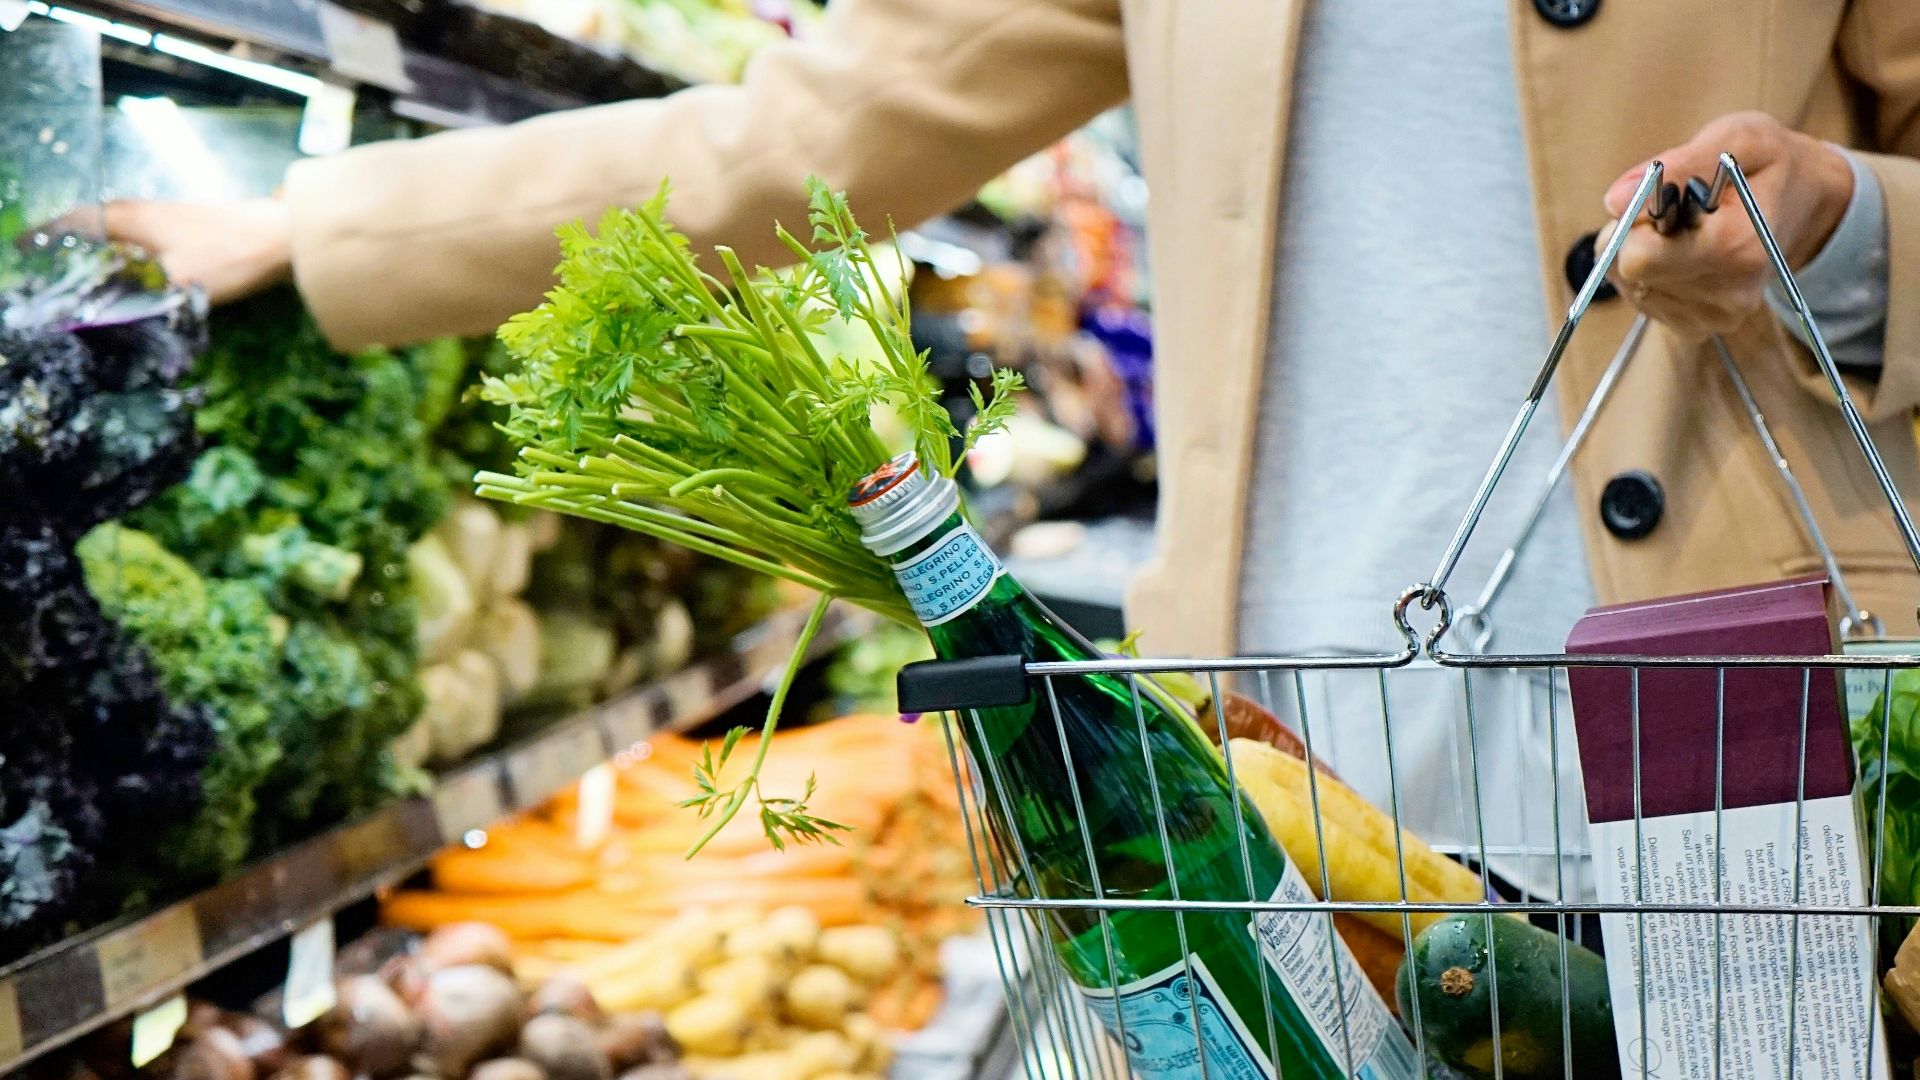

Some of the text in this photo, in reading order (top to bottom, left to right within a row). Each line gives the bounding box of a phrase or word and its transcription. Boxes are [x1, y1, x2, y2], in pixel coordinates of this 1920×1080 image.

[1681, 828, 1694, 850] Seul
[1703, 832, 1714, 846] de
[1821, 823, 1836, 866] delicious
[1616, 845, 1627, 869] vous
[1646, 836, 1663, 880] Délicieux
[1684, 852, 1693, 865] un
[1743, 848, 1757, 884] cheese
[1754, 847, 1766, 864] but
[1764, 841, 1779, 869] these
[1834, 845, 1849, 877] Lesley
[1619, 870, 1629, 883] ne
[1755, 865, 1769, 892] really
[1804, 862, 1816, 879] her
[1653, 881, 1662, 894] au
[1685, 866, 1700, 900] produit
[1748, 885, 1757, 896] or
[1768, 870, 1782, 903] unique
[1807, 881, 1818, 906] team
[1840, 878, 1853, 906] Stow
[1624, 921, 1637, 943] plus
[1648, 921, 1658, 934] de
[1679, 912, 1695, 948] pouvait
[1764, 920, 1776, 946] when
[1800, 921, 1813, 955] scratch
[1823, 921, 1835, 942] with
[1660, 932, 1669, 950] ces
[1670, 928, 1684, 960] POUR
[1728, 934, 1741, 964] Foods
[1744, 935, 1754, 944] &
[1814, 932, 1824, 948] the
[1834, 924, 1849, 965] fabulous
[1847, 934, 1861, 965] Foods
[1694, 842, 1704, 865] avec
[1722, 1057, 1733, 1070] de
[1745, 945, 1755, 962] are
[1756, 944, 1767, 960] We
[1778, 946, 1788, 962] are
[1815, 950, 1827, 970] only
[1826, 943, 1836, 966] care
[1661, 951, 1678, 1000] craquelins
[1674, 960, 1687, 984] CES
[1686, 948, 1701, 991] satisfaire
[1719, 954, 1734, 993] fabuleux
[1748, 963, 1758, 985] sure
[1758, 962, 1768, 978] are
[1766, 948, 1781, 981] topped
[1804, 957, 1816, 983] using
[1829, 967, 1839, 977] in
[1851, 966, 1860, 981] we
[1701, 977, 1712, 1000] avec
[1732, 965, 1744, 993] adore
[1817, 972, 1828, 991] way
[1839, 966, 1852, 995] crisps
[1656, 984, 1666, 997] de
[1678, 985, 1691, 1010] FINS
[1749, 986, 1760, 1005] you
[1760, 979, 1775, 1020] addicted
[1772, 982, 1784, 1002] with
[1809, 984, 1818, 1000] our
[1822, 993, 1831, 1003] to
[1830, 978, 1843, 1004] small
[1853, 982, 1865, 1003] love
[1669, 1001, 1680, 1022] sont
[1691, 992, 1705, 1023] Lesley
[1704, 1001, 1715, 1020] des
[1734, 994, 1751, 1037] fabriquer
[1753, 1006, 1764, 1021] will
[1774, 1003, 1785, 1024] your
[1811, 1001, 1824, 1028] finest
[1823, 1004, 1834, 1030] make
[1844, 996, 1855, 1018] from
[1657, 998, 1673, 1039] fromage
[1696, 1024, 1706, 1035] et
[1724, 995, 1741, 1044] craquelins
[1756, 1023, 1765, 1036] be
[1766, 1021, 1776, 1032] to
[1663, 1039, 1673, 1052] ou
[1698, 1036, 1708, 1054] son
[1742, 1038, 1751, 1048] et
[1768, 1033, 1779, 1050] this
[1845, 1019, 1862, 1058] Lesley's
[1732, 1045, 1743, 1066] sont
[1743, 1049, 1754, 1072] vous
[1826, 1041, 1839, 1066] great
